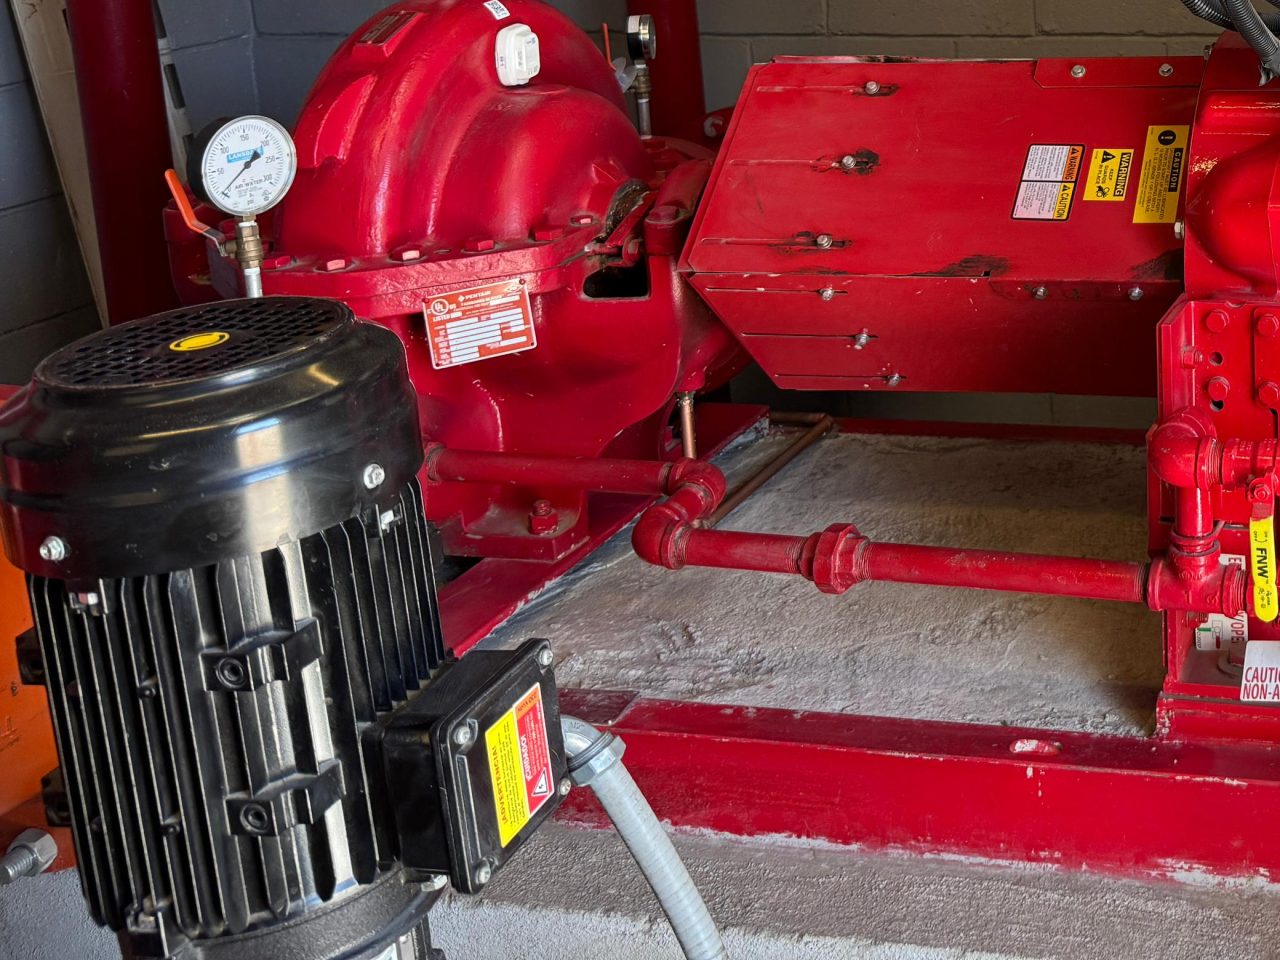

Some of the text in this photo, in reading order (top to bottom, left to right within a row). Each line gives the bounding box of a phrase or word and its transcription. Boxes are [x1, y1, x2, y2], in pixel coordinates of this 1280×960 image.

[1065, 156, 1079, 180] WARNING
[1115, 154, 1131, 196] WARNING
[1170, 151, 1182, 188] CAUTION
[1056, 192, 1069, 218] CAUTION
[1256, 547, 1269, 579] FNW
